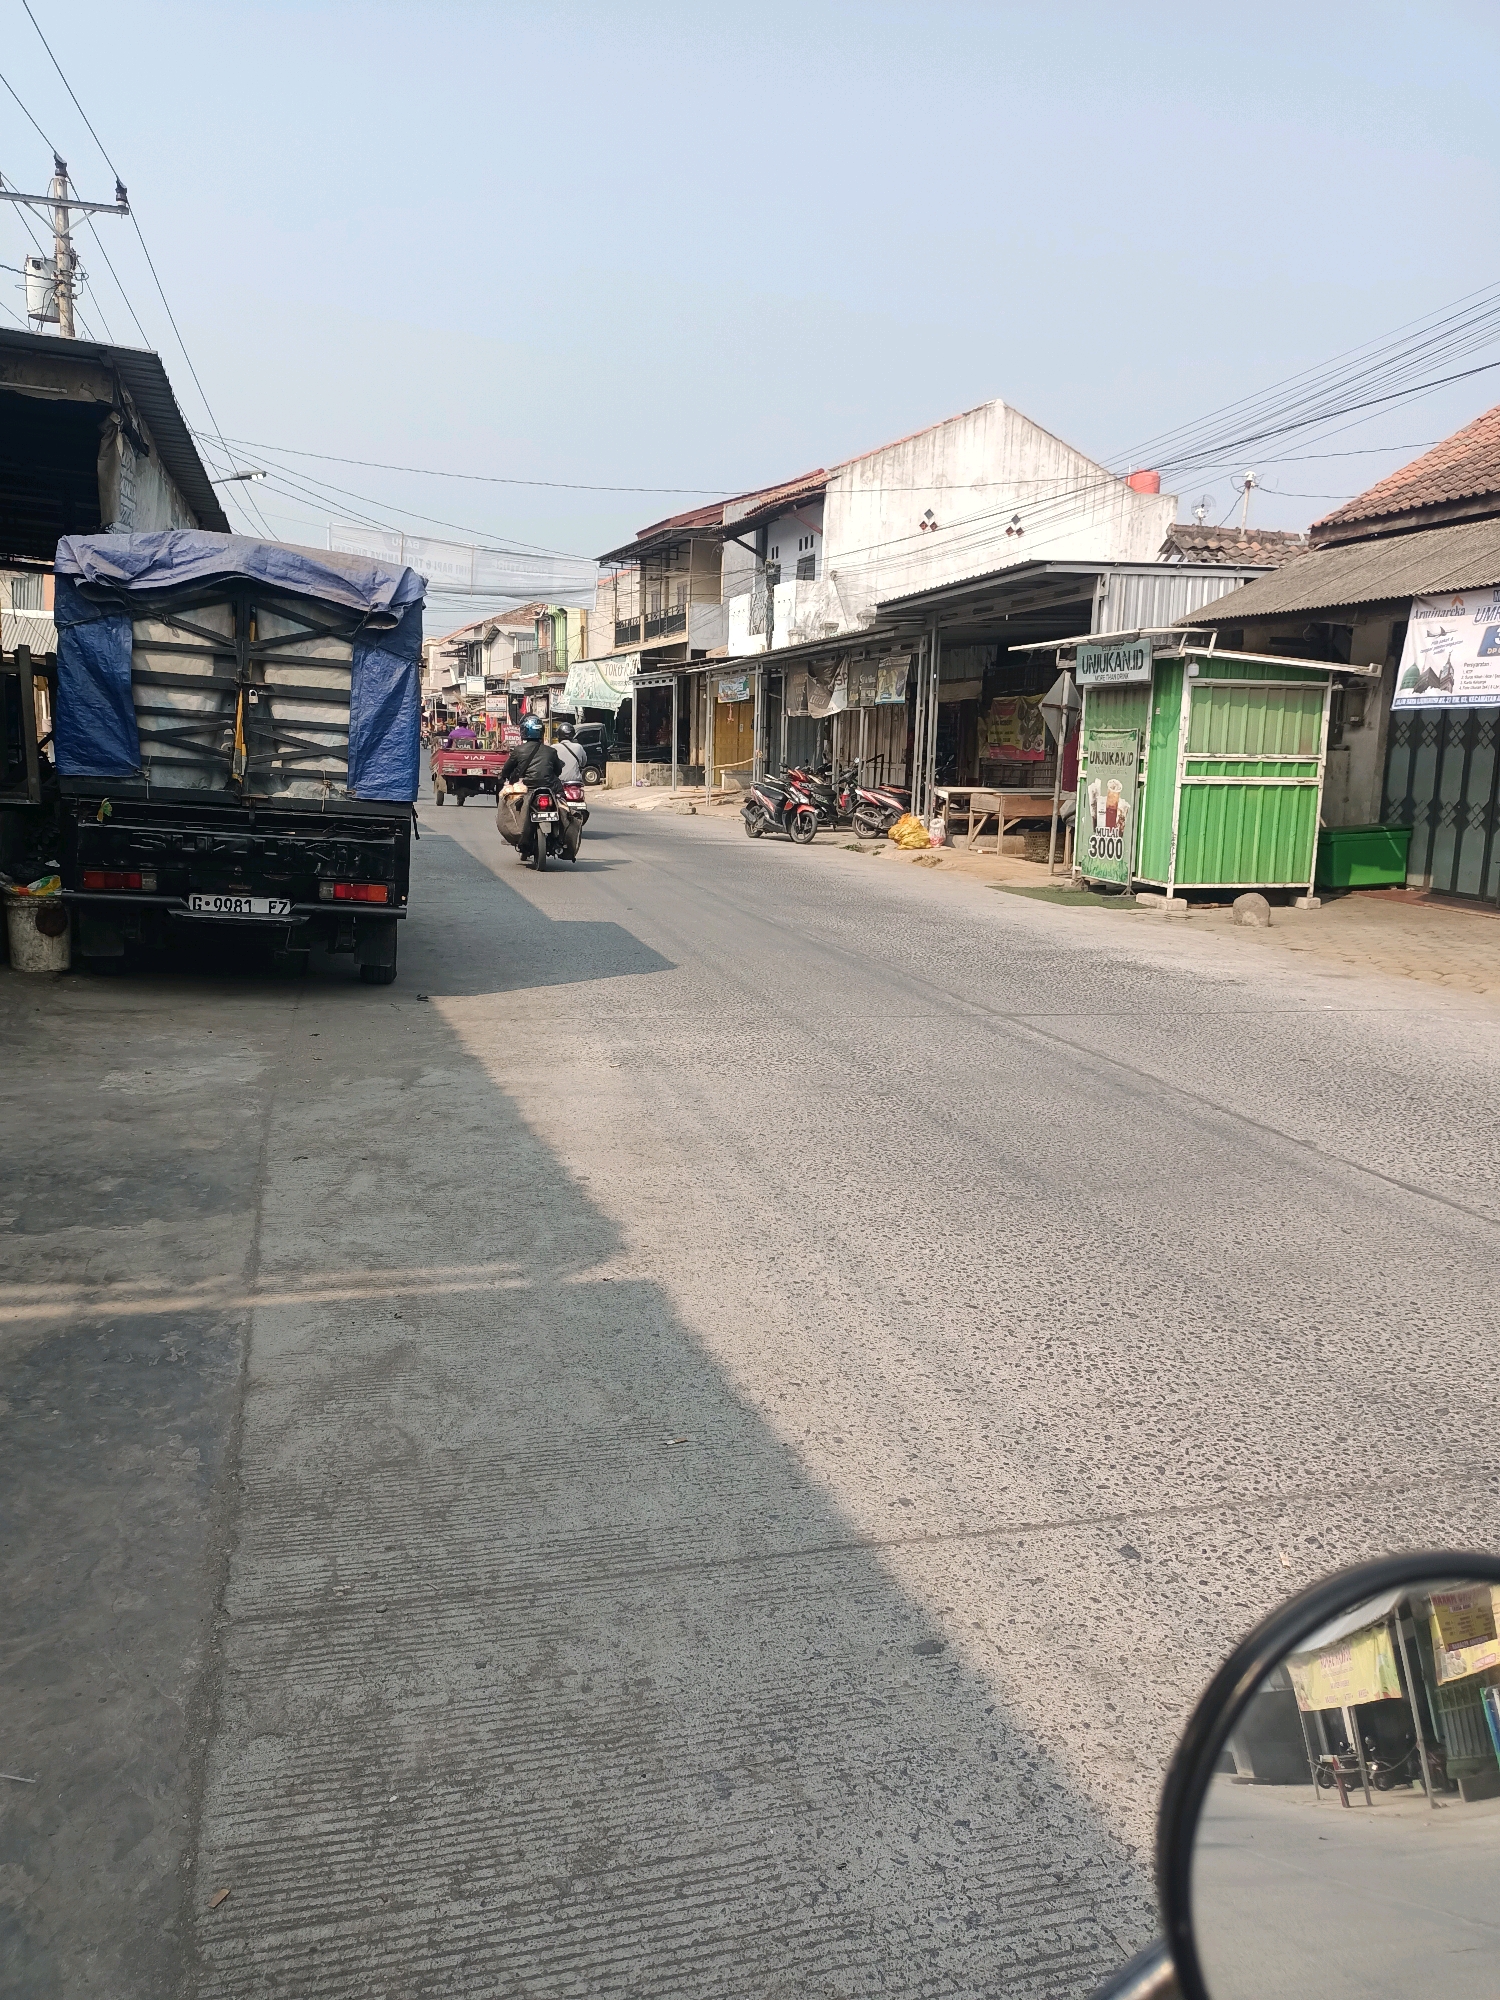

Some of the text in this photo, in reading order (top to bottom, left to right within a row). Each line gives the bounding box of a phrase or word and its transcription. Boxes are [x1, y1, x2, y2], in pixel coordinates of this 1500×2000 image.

[1081, 649, 1144, 675] UNJUKAN.ID
[1095, 673, 1105, 682] MORE
[1096, 827, 1119, 837] MULAI
[1089, 837, 1123, 859] 3000
[213, 897, 252, 913] 9981
